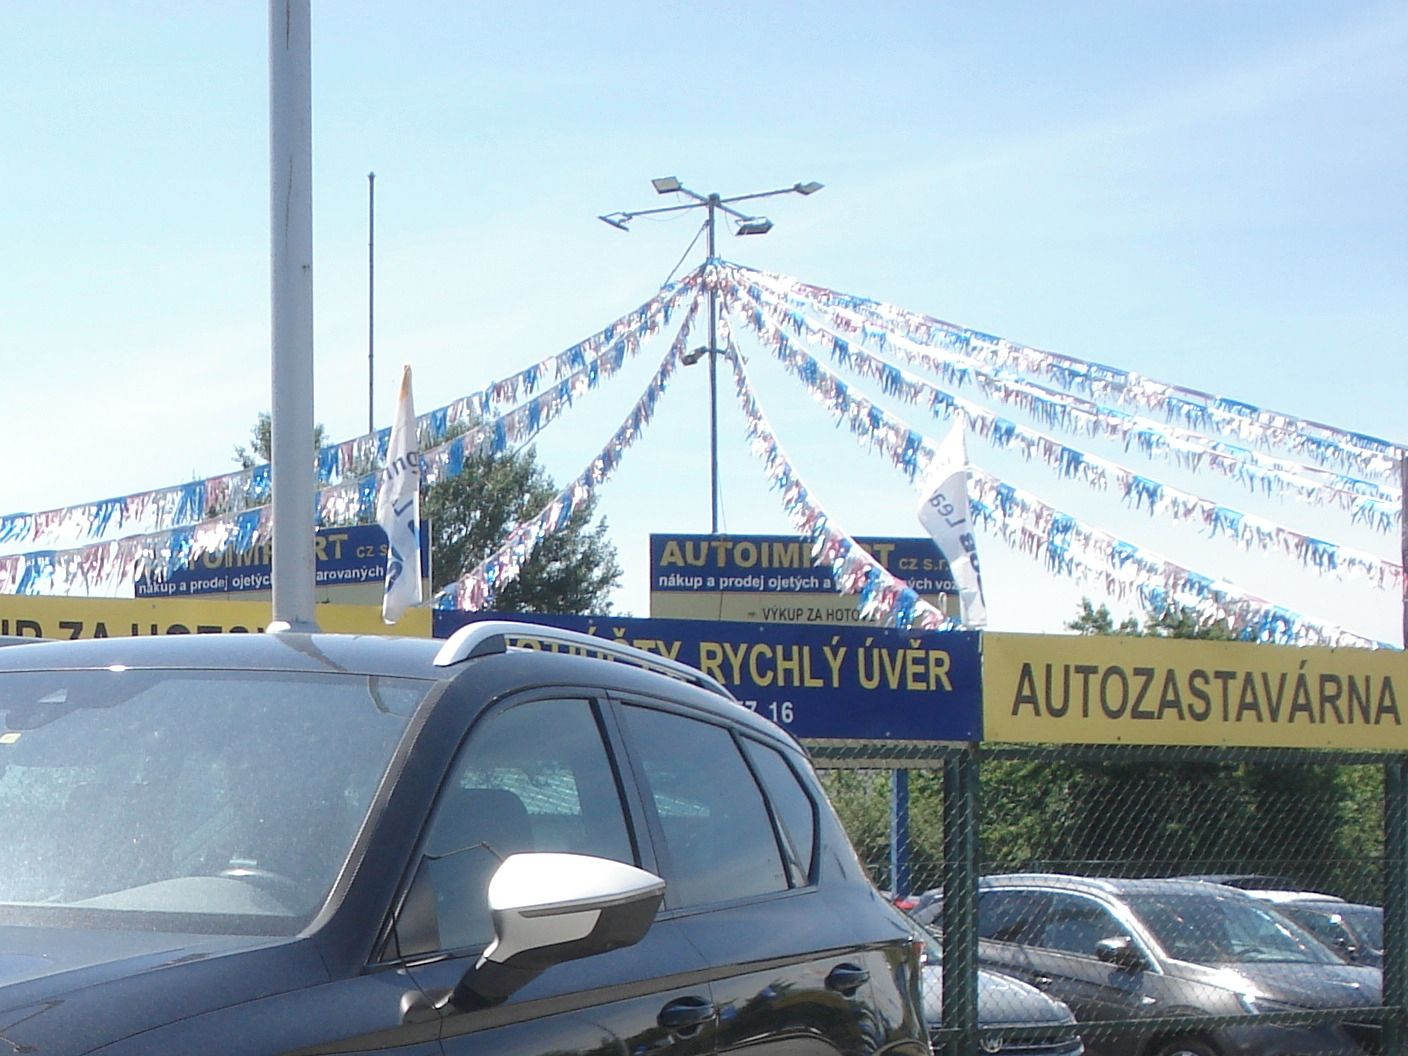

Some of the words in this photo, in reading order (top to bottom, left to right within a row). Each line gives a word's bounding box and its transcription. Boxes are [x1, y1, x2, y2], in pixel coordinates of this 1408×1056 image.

[190, 575, 228, 593] prodej
[232, 572, 273, 590] ojetýc
[658, 573, 703, 589] nákup
[706, 577, 715, 587] a
[719, 575, 765, 590] prodej
[768, 576, 819, 591] ojetých
[823, 579, 831, 589] a
[762, 604, 804, 622] VÝKUP
[807, 608, 823, 622] ZA
[699, 636, 847, 688] RYCHLÝ
[857, 637, 954, 692] ÚVĚR
[1011, 659, 1402, 726] AUTOZASTAVÁRNA
[769, 701, 794, 724] 16
